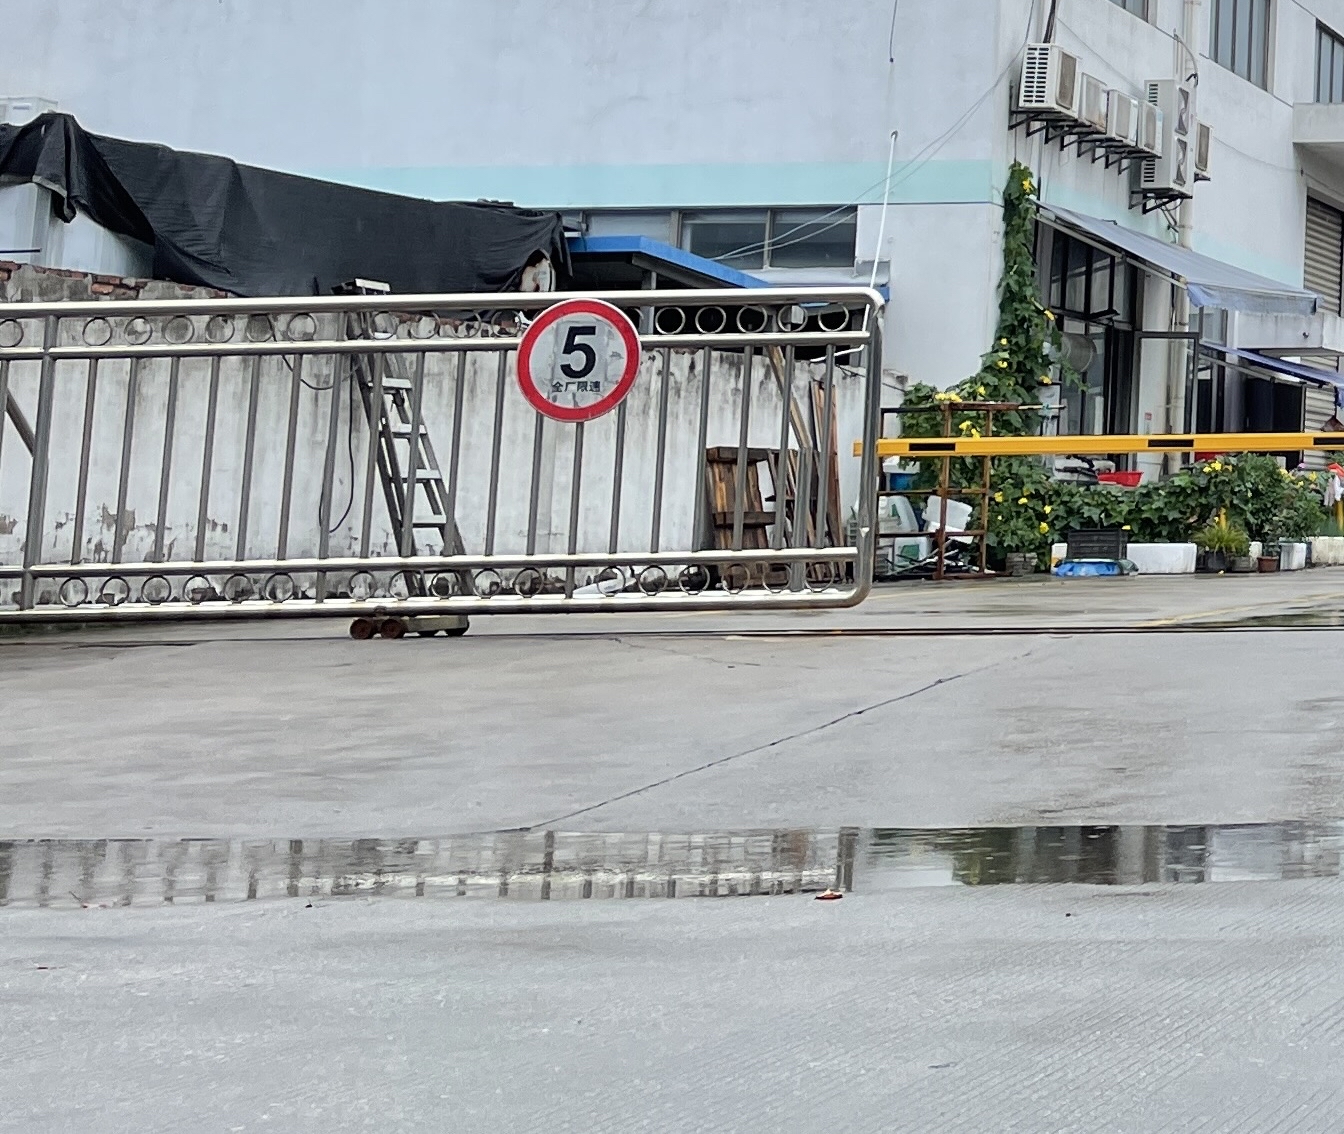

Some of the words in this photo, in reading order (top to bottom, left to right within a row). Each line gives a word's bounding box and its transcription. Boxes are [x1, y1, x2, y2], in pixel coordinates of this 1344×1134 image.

[560, 325, 597, 379] 5
[551, 380, 601, 393] 全厂限速
